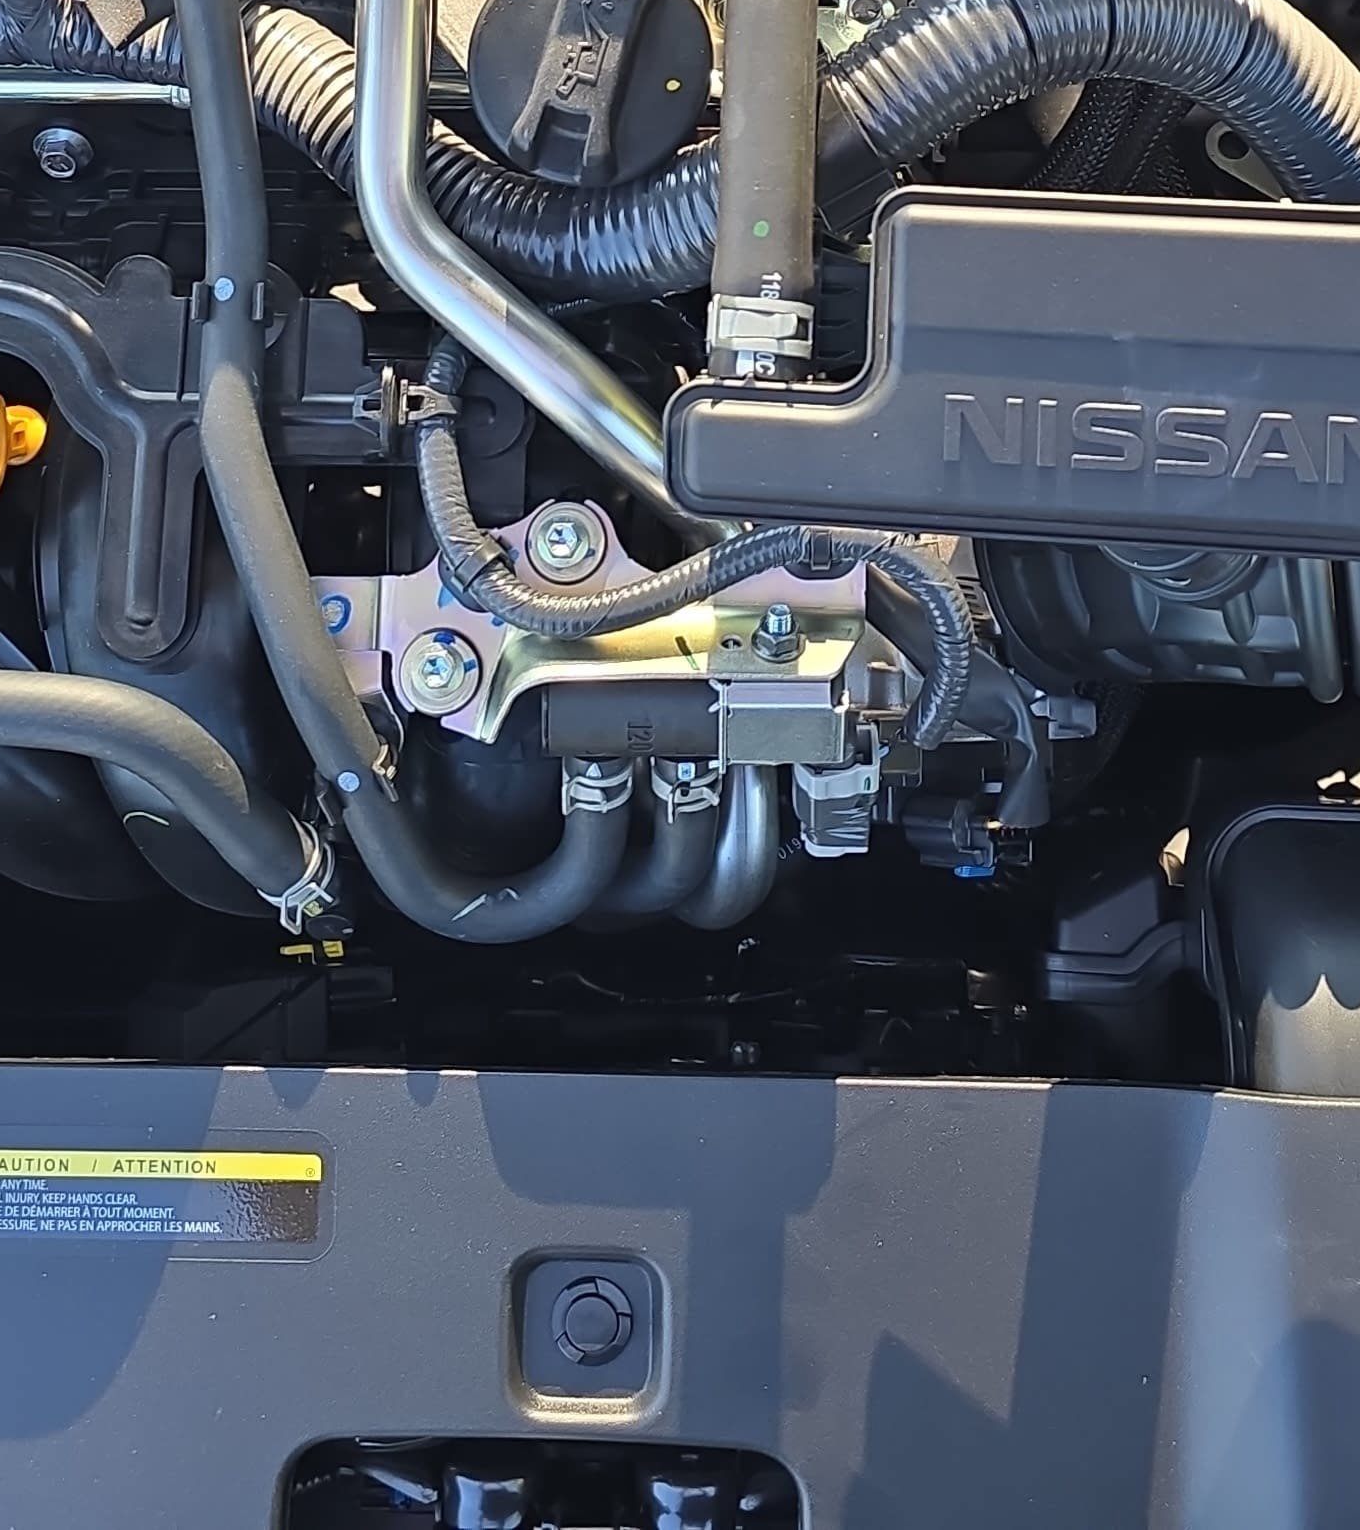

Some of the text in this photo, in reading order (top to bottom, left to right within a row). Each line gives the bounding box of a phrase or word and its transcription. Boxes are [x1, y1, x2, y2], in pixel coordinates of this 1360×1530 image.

[112, 1159, 217, 1174] ATTENTION
[1, 1180, 22, 1190] ANY
[5, 1192, 40, 1205] INJURY,
[42, 1193, 66, 1204] KEEP
[68, 1193, 103, 1205] HANDS
[105, 1193, 137, 1205] CLEAR.
[4, 1206, 19, 1217] DE
[21, 1204, 80, 1218] DÉMARRER
[82, 1204, 91, 1218] À
[93, 1207, 122, 1219] TOUT
[123, 1208, 176, 1219] MOMENT.
[40, 1220, 56, 1231] NE
[58, 1220, 78, 1231] PAS
[79, 1221, 94, 1231] EN
[96, 1221, 164, 1233] APPROCHER
[164, 1222, 183, 1233] LES
[184, 1222, 223, 1234] MAINS.
